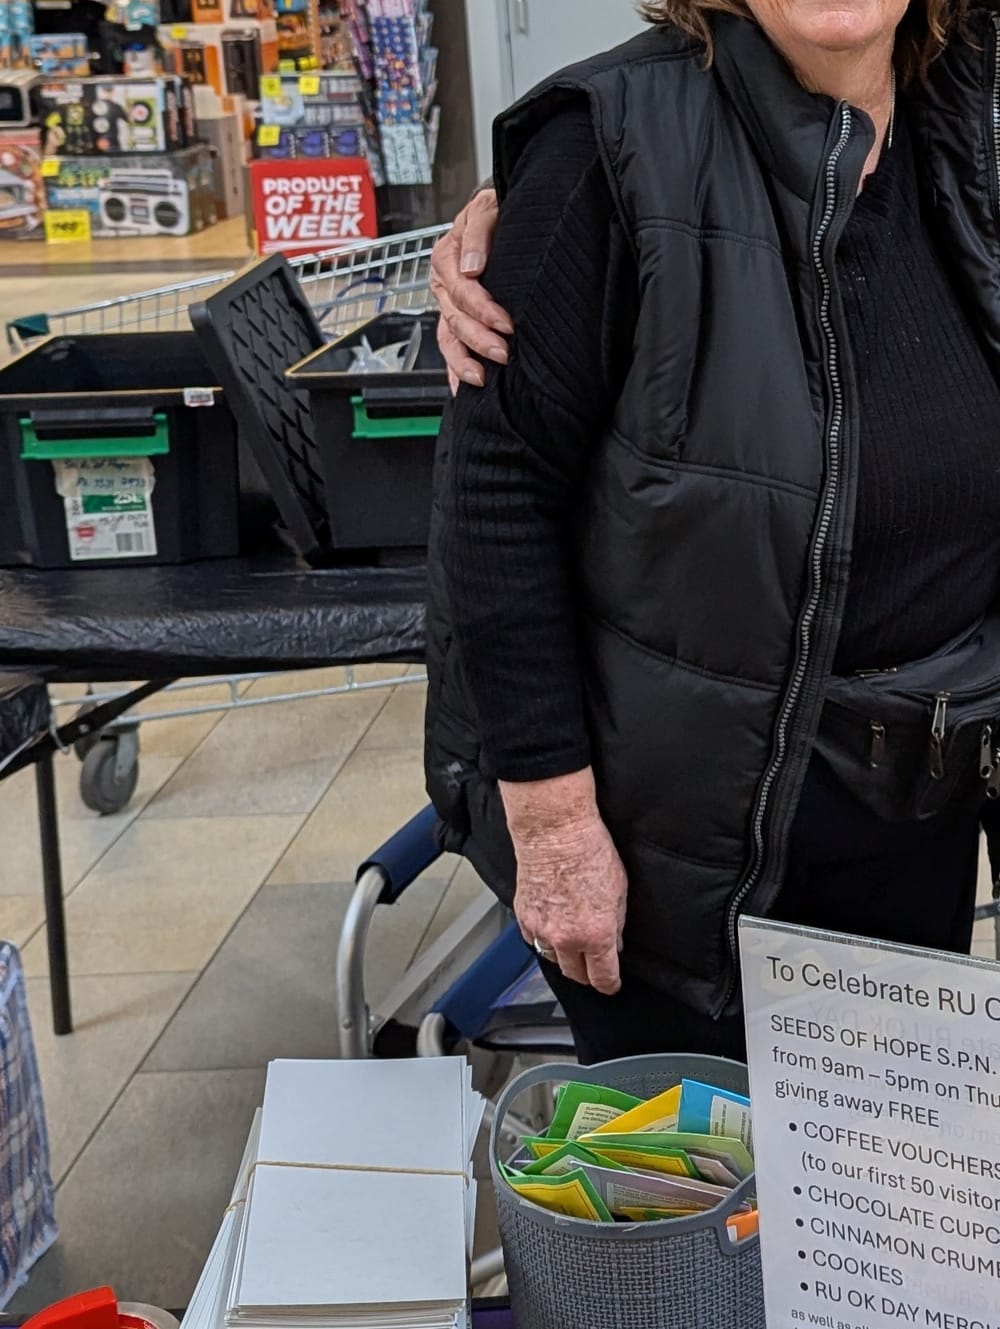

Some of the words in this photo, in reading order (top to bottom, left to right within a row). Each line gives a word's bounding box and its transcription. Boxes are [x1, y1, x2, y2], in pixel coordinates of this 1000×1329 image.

[262, 175, 363, 195] PRODUCT
[265, 195, 305, 216] OF
[310, 193, 362, 214] THE
[265, 213, 365, 240] WEEK
[766, 956, 794, 982] To
[802, 963, 930, 1008] Celebrate
[938, 987, 976, 1015] RU
[770, 1014, 835, 1043] SEEDS
[840, 1028, 867, 1049] OF
[873, 1034, 932, 1063] HOPE
[937, 1047, 997, 1075] S.P.N.
[772, 1046, 816, 1071] from
[821, 1056, 864, 1081] 9am
[884, 1069, 929, 1094] 5pm
[935, 1082, 960, 1100] on
[775, 1079, 829, 1108] giving
[833, 1093, 884, 1119] away
[888, 1101, 940, 1128] FREE
[803, 1121, 884, 1154] COFFEE
[801, 1151, 826, 1172] (to
[831, 1161, 863, 1180] our
[867, 1166, 906, 1190] first
[911, 1176, 934, 1196] 50
[808, 1185, 934, 1230] CHOCOLATE
[810, 1217, 925, 1260] CINNAMON
[812, 1249, 904, 1286] COOKIES
[791, 1309, 806, 1320] as
[808, 1312, 835, 1329] well
[815, 1280, 842, 1302] RU
[847, 1289, 877, 1312] OK
[881, 1297, 919, 1323] DAY
